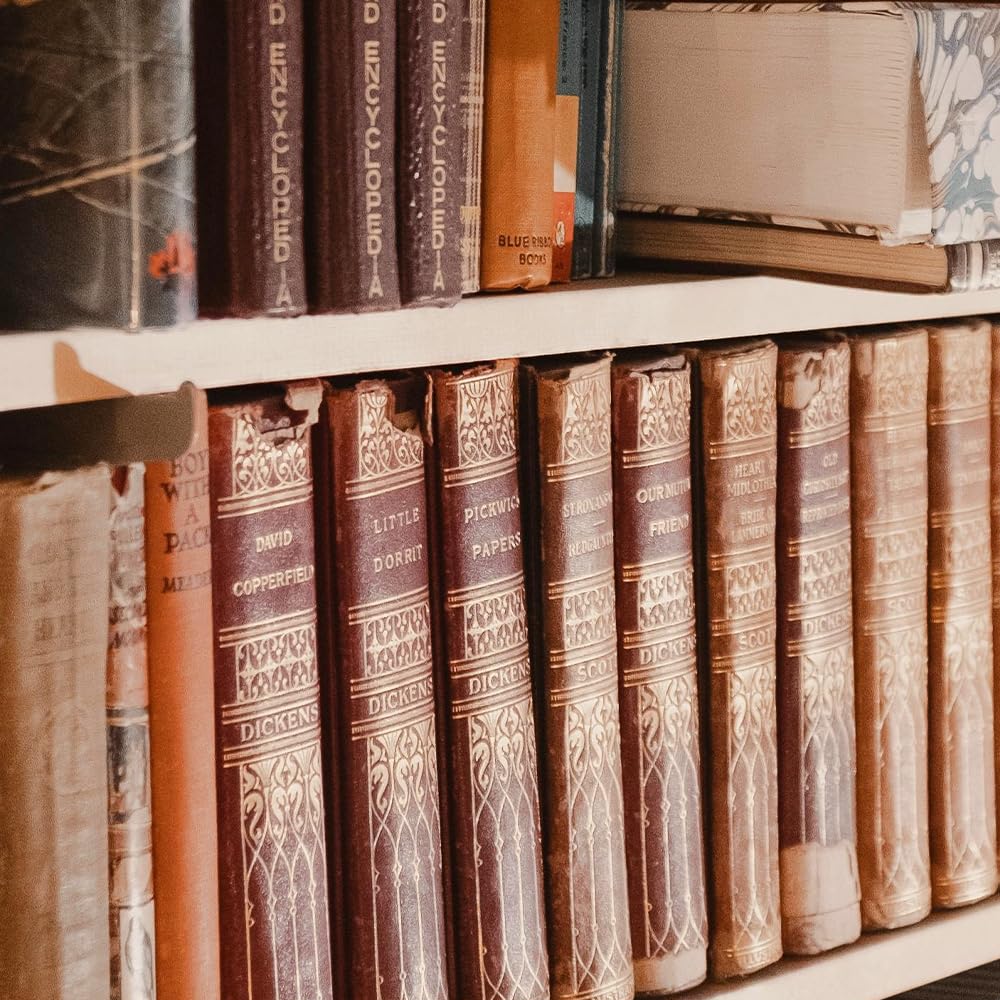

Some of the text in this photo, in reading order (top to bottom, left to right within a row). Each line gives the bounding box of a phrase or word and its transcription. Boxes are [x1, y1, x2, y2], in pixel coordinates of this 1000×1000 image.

[269, 42, 292, 306] ENCYCLOPEDIA
[364, 40, 383, 298] ENCYCLOPEDIA
[432, 41, 446, 291] ENCYCLOPEDIA
[498, 234, 529, 248] BLUE
[636, 486, 664, 503] OUR
[373, 506, 420, 535] LITTLE
[256, 529, 293, 553] DAVID
[472, 531, 521, 560] PAPERS
[374, 544, 423, 573] DORRIT
[232, 565, 315, 597] COPPERFIELD
[468, 658, 531, 696] DICKENS
[368, 676, 433, 716] DICKENS
[240, 702, 319, 742] DICKENS
